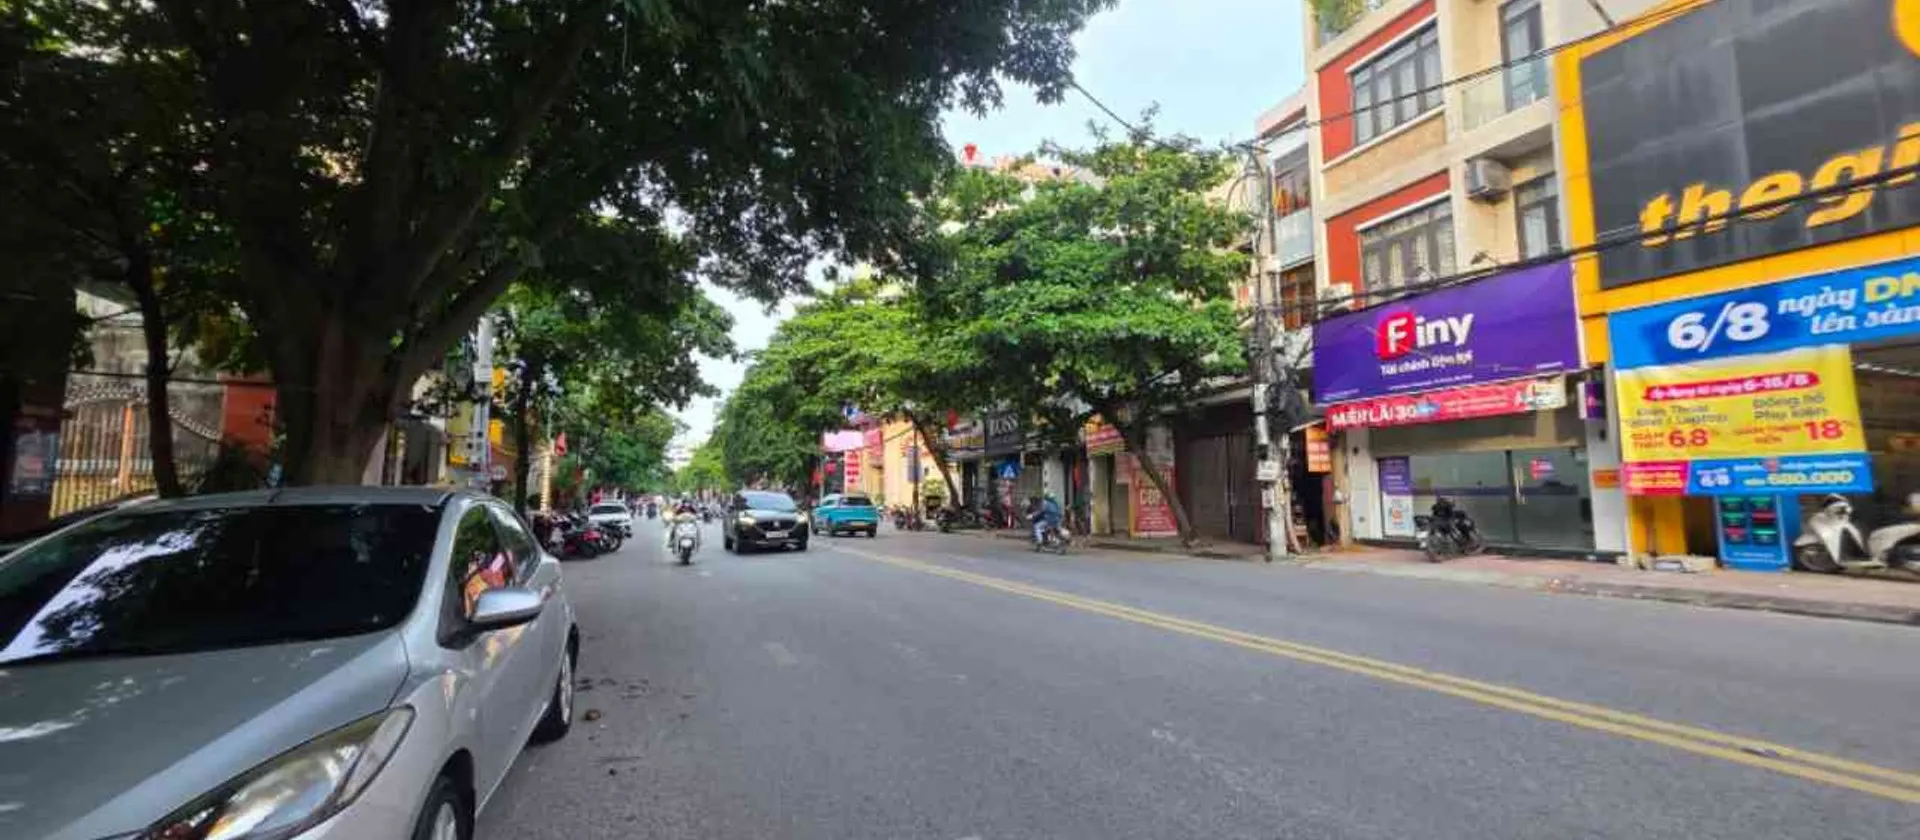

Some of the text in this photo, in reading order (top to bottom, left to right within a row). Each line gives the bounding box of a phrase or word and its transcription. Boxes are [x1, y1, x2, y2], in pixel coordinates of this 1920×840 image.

[1387, 313, 1474, 354] Finy
[1667, 301, 1770, 353] 6/8
[1777, 285, 1858, 317] ngày
